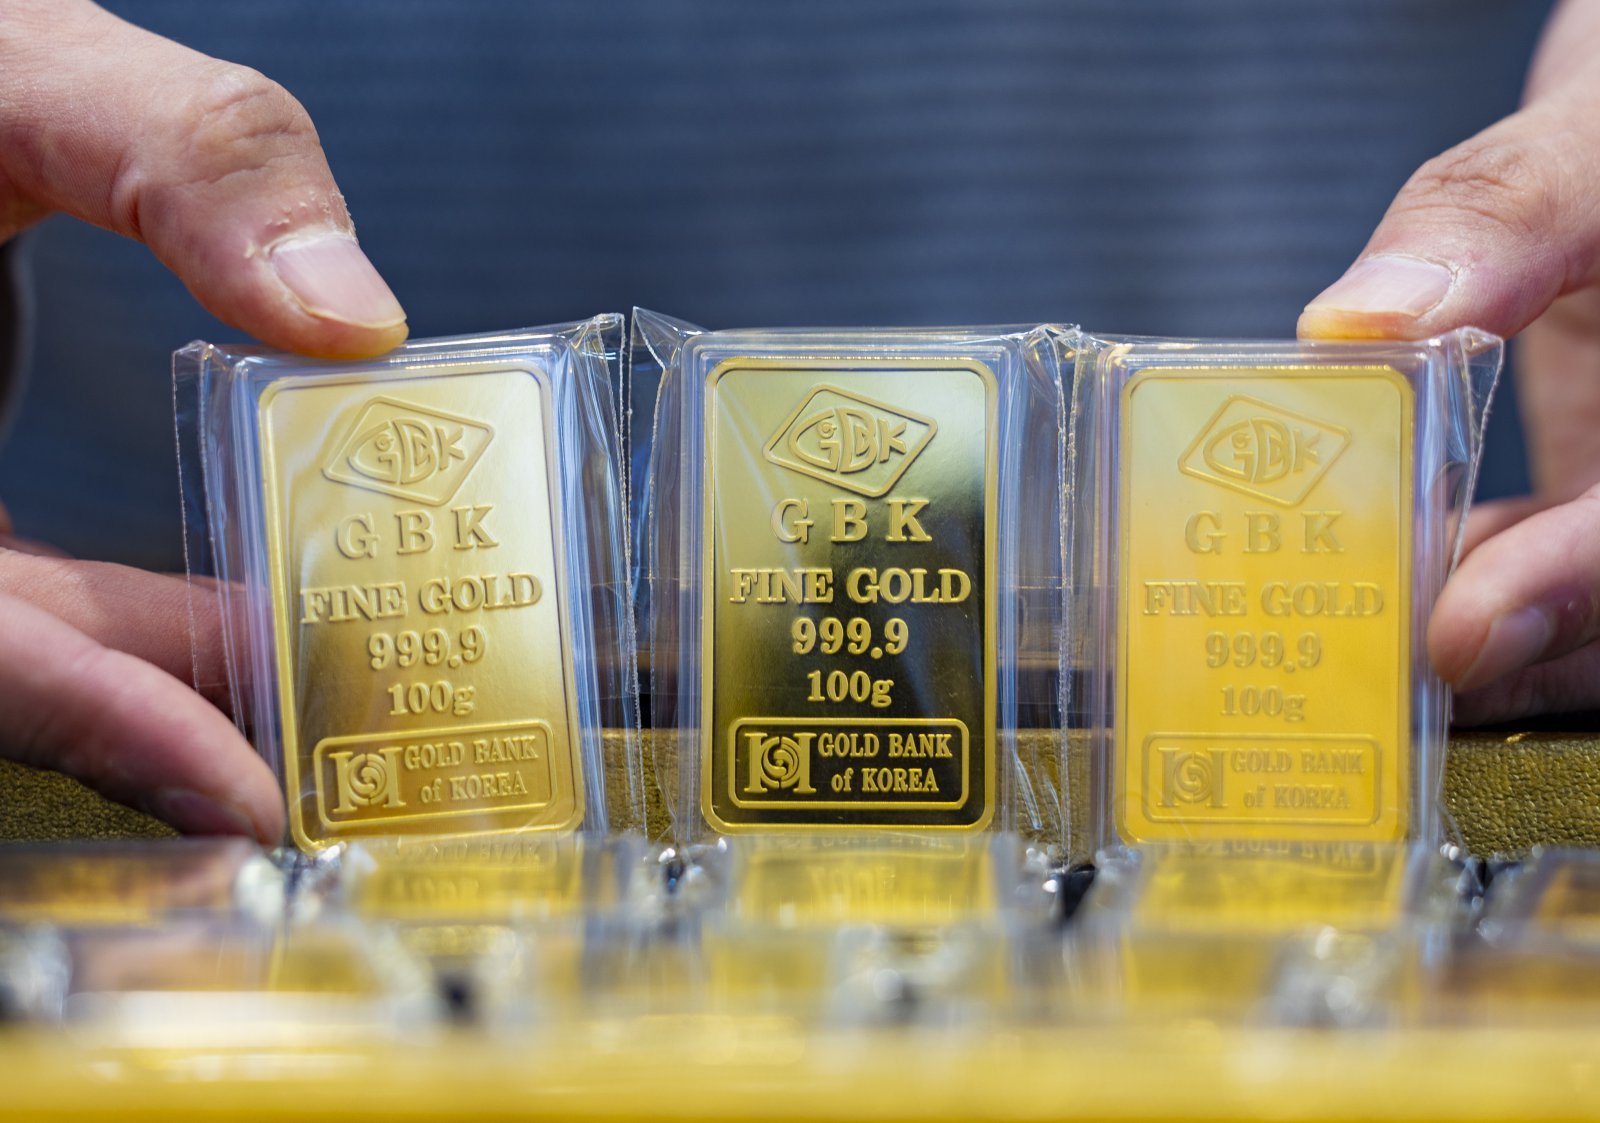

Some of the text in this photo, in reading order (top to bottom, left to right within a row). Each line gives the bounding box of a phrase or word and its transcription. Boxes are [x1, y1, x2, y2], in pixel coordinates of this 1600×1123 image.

[300, 572, 543, 624] FINE GOLD
[729, 568, 972, 603] FINE GOLD
[1143, 582, 1384, 617] FINE GOLD
[369, 626, 486, 669] 999.9
[791, 618, 909, 658] 999.9
[1205, 631, 1322, 672] 999.9
[389, 680, 475, 716] 100g
[807, 671, 894, 707] 100g
[1220, 685, 1306, 721] 100g
[404, 733, 539, 771] GOLD BANK
[818, 732, 952, 758] GOLD BANK
[1230, 748, 1365, 774] GOLD BANK
[420, 770, 528, 804] of KOREA
[831, 768, 939, 792] of KOREA
[1243, 785, 1350, 809] of KOREA
